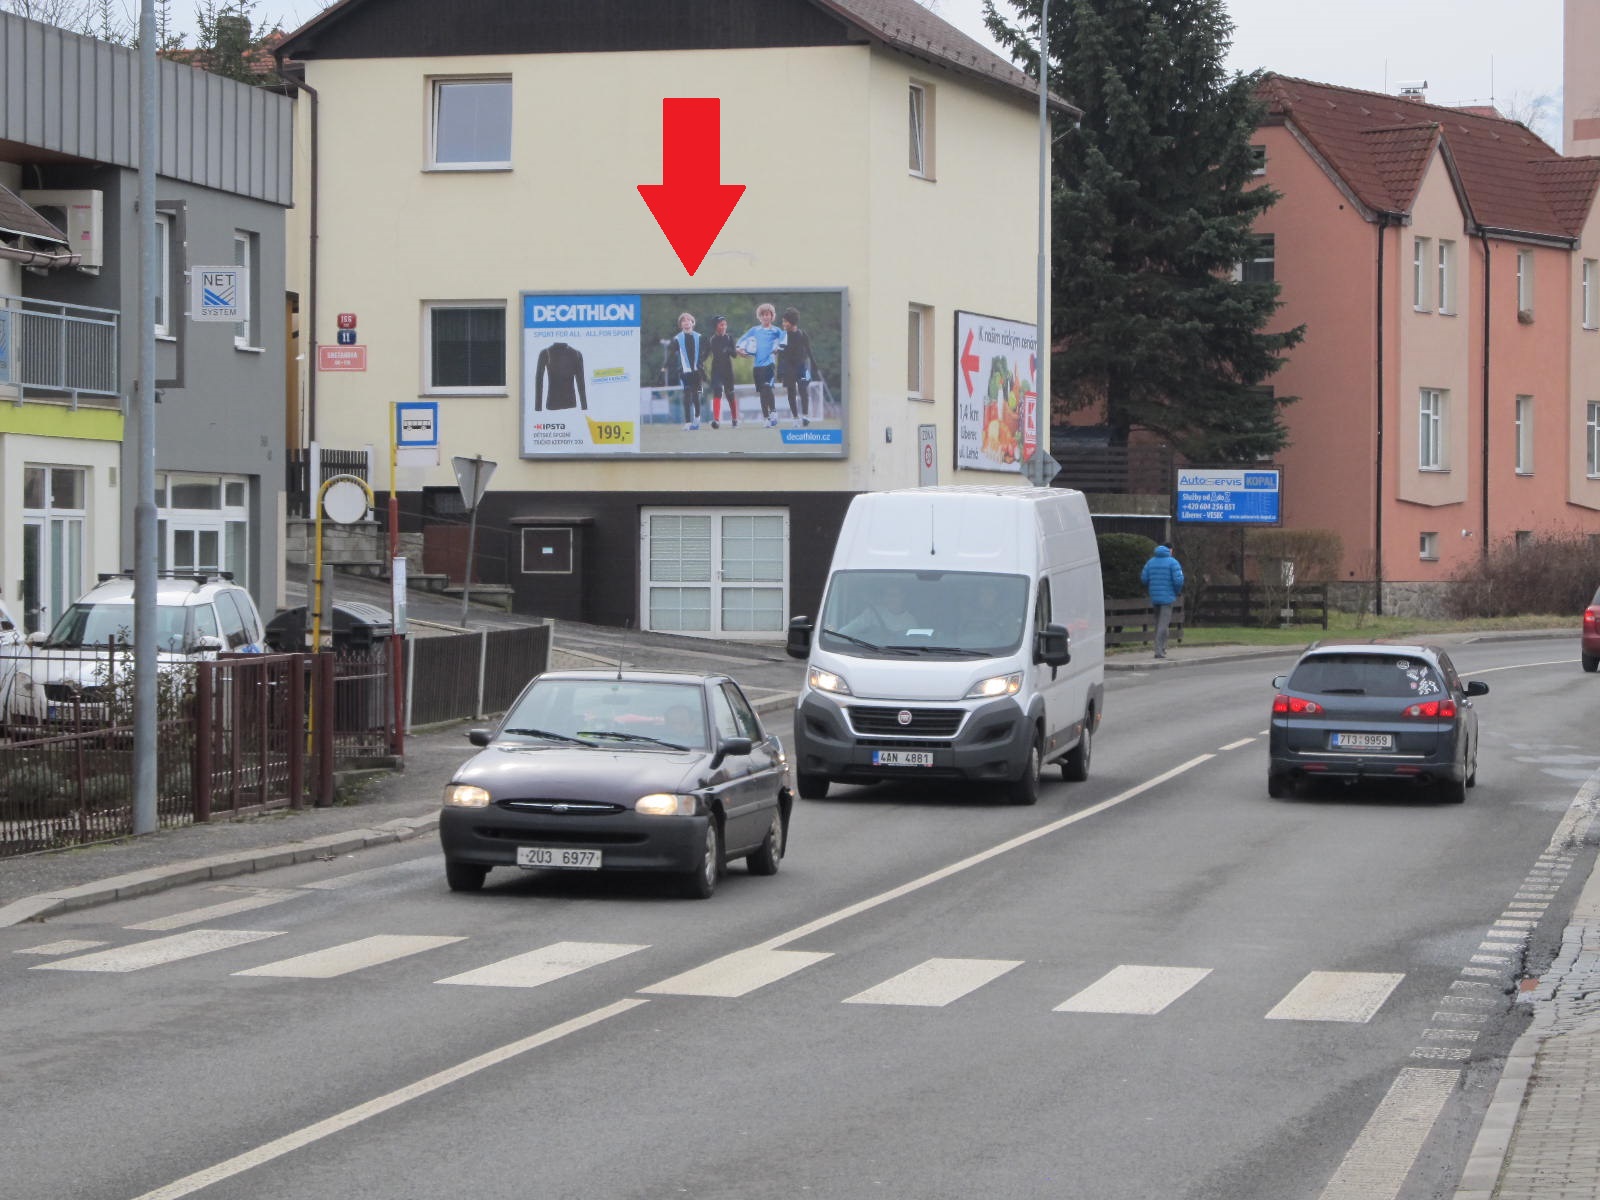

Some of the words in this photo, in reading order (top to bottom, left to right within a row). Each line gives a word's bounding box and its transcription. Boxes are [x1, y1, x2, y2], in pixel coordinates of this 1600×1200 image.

[203, 274, 234, 286] NET
[201, 308, 236, 316] SYSTEM
[533, 303, 635, 322] DECATHLON
[978, 326, 984, 341] K
[969, 403, 979, 422] km
[597, 425, 631, 442] 199,-
[786, 432, 831, 441] decathlon.cz
[922, 430, 934, 441] ZONA
[960, 424, 977, 441] Liberec
[1182, 493, 1202, 503] Služby
[1202, 493, 1211, 501] od
[1181, 511, 1203, 519] Liberec
[1206, 511, 1224, 519] VESEC
[1340, 735, 1359, 744] 7T3
[1364, 736, 1388, 745] 9959
[881, 752, 898, 763] 4AN
[905, 753, 929, 764] 4881
[528, 850, 552, 864] 2U3
[562, 851, 595, 865] 6977
